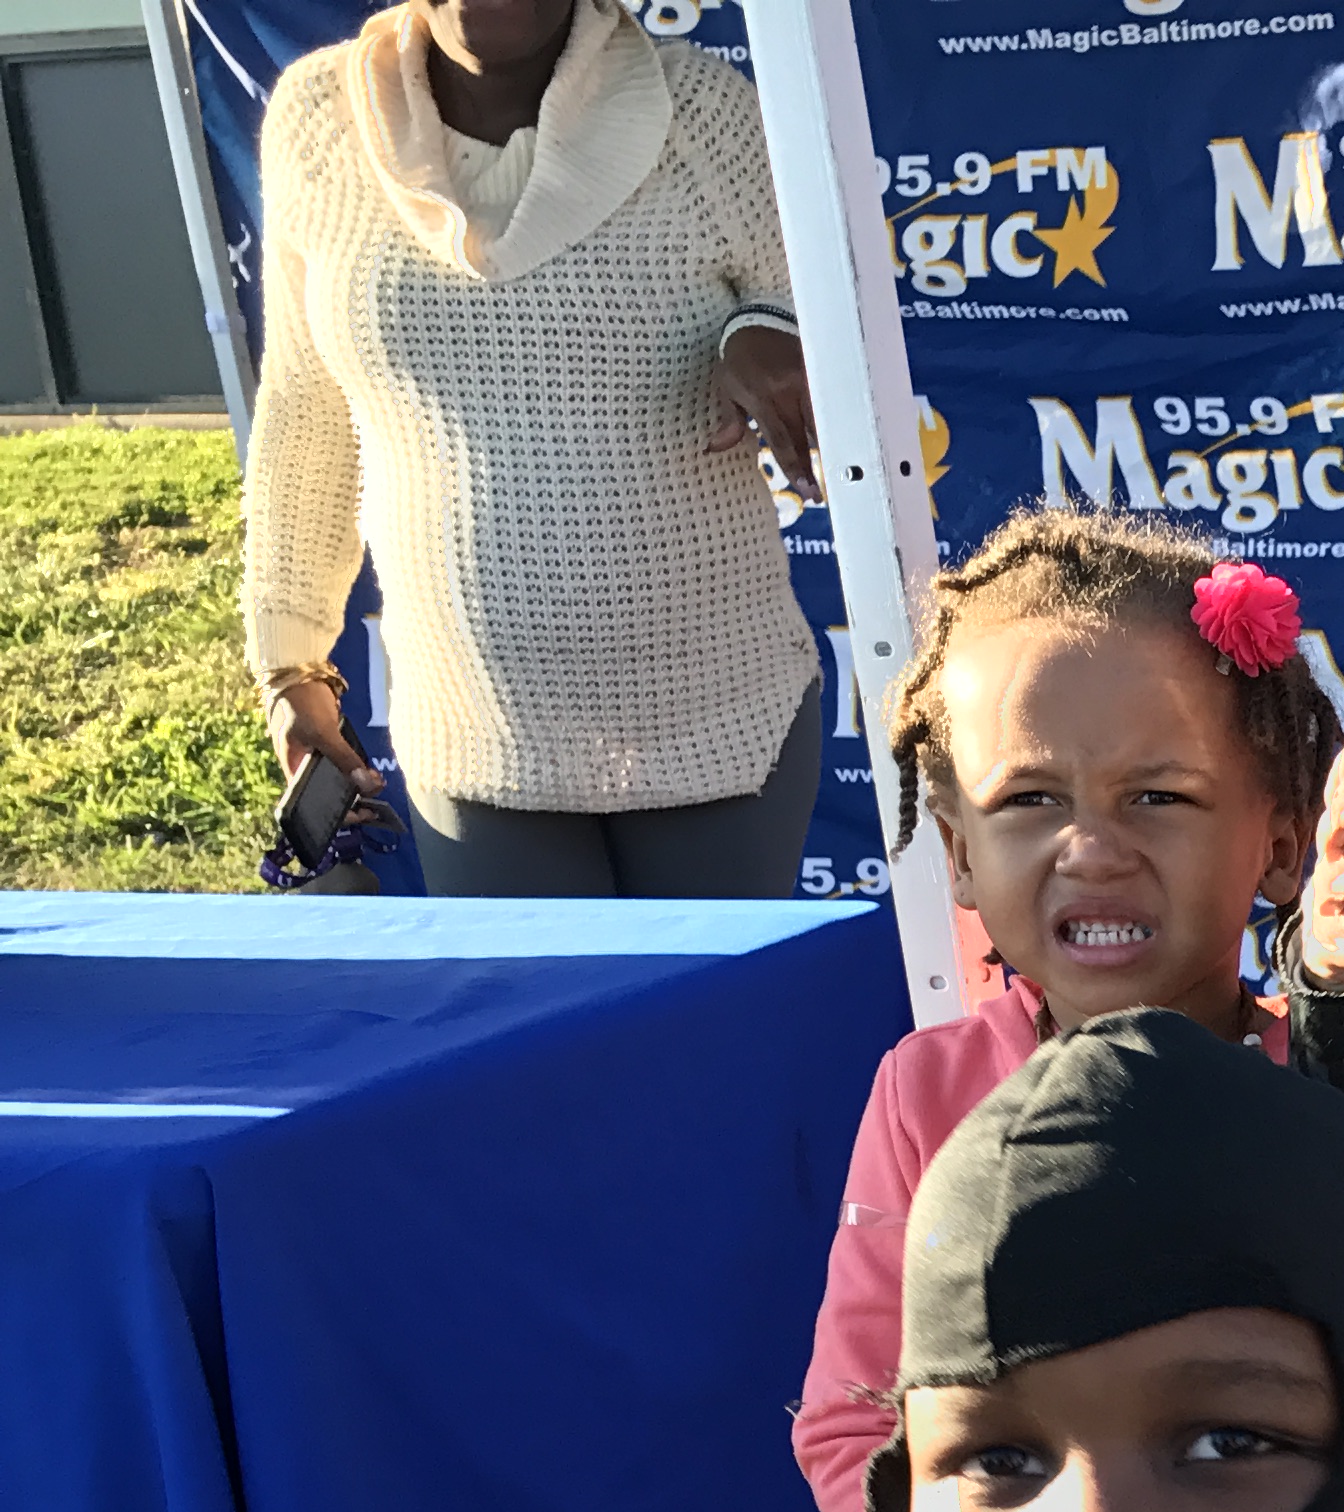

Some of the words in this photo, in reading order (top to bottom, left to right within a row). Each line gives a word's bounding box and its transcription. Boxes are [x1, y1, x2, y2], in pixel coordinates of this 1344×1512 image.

[938, 12, 1335, 54] www.MagicBaltimore.com
[1016, 146, 1108, 194] FM
[885, 211, 1045, 297] gic
[1153, 396, 1290, 437] 95.9
